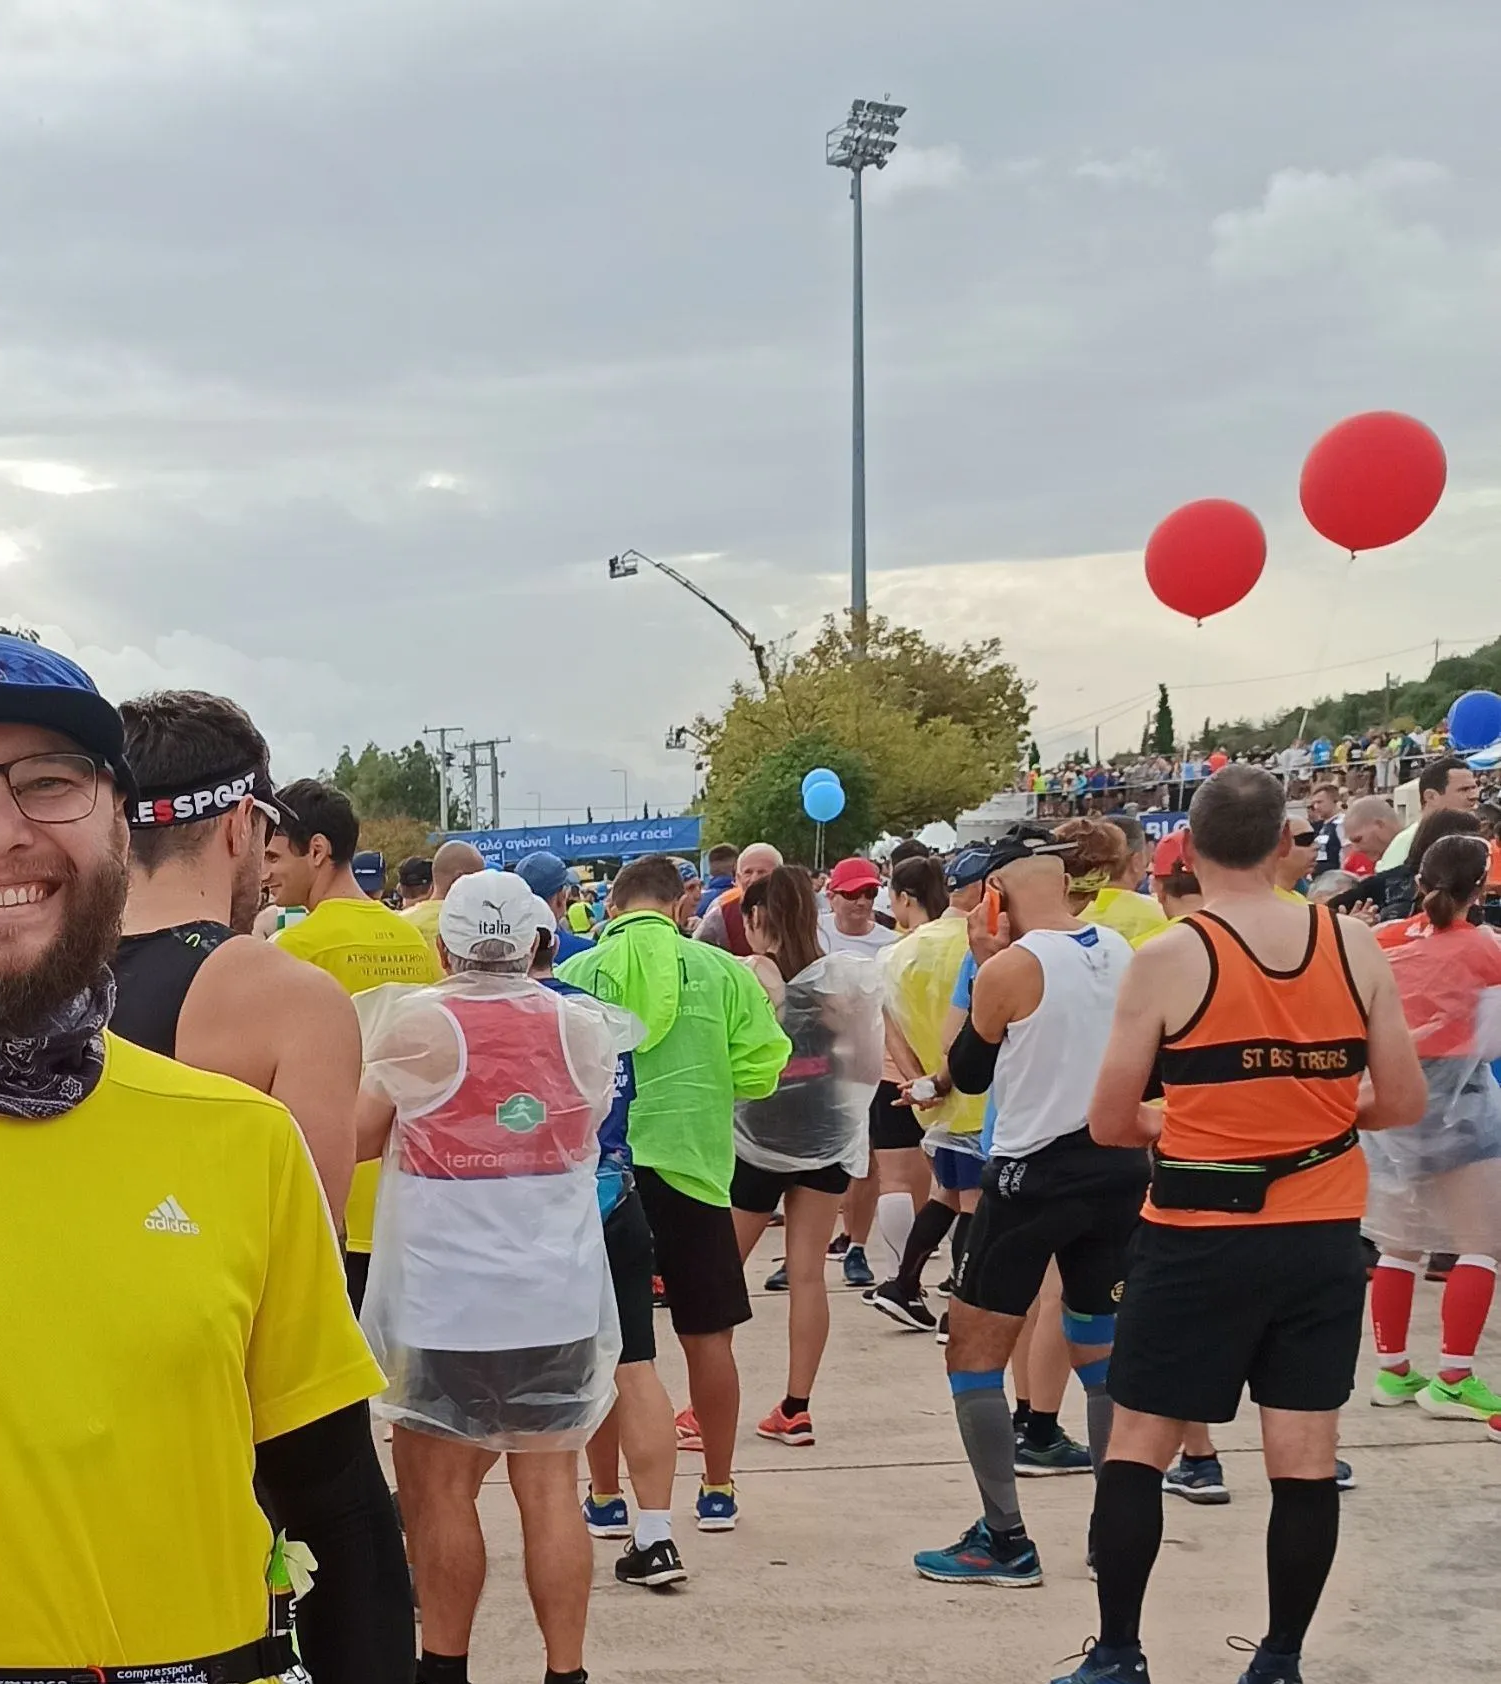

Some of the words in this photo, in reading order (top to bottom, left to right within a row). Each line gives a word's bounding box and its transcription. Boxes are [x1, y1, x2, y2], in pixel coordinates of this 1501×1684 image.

[132, 772, 256, 823] ESSPORT
[564, 832, 598, 846] Have
[600, 833, 608, 844] a
[610, 829, 639, 843] nice
[640, 826, 673, 841] race!
[478, 919, 511, 935] italia
[1242, 1048, 1264, 1069] ST
[144, 1216, 200, 1235] adidas
[117, 1663, 193, 1680] compressport
